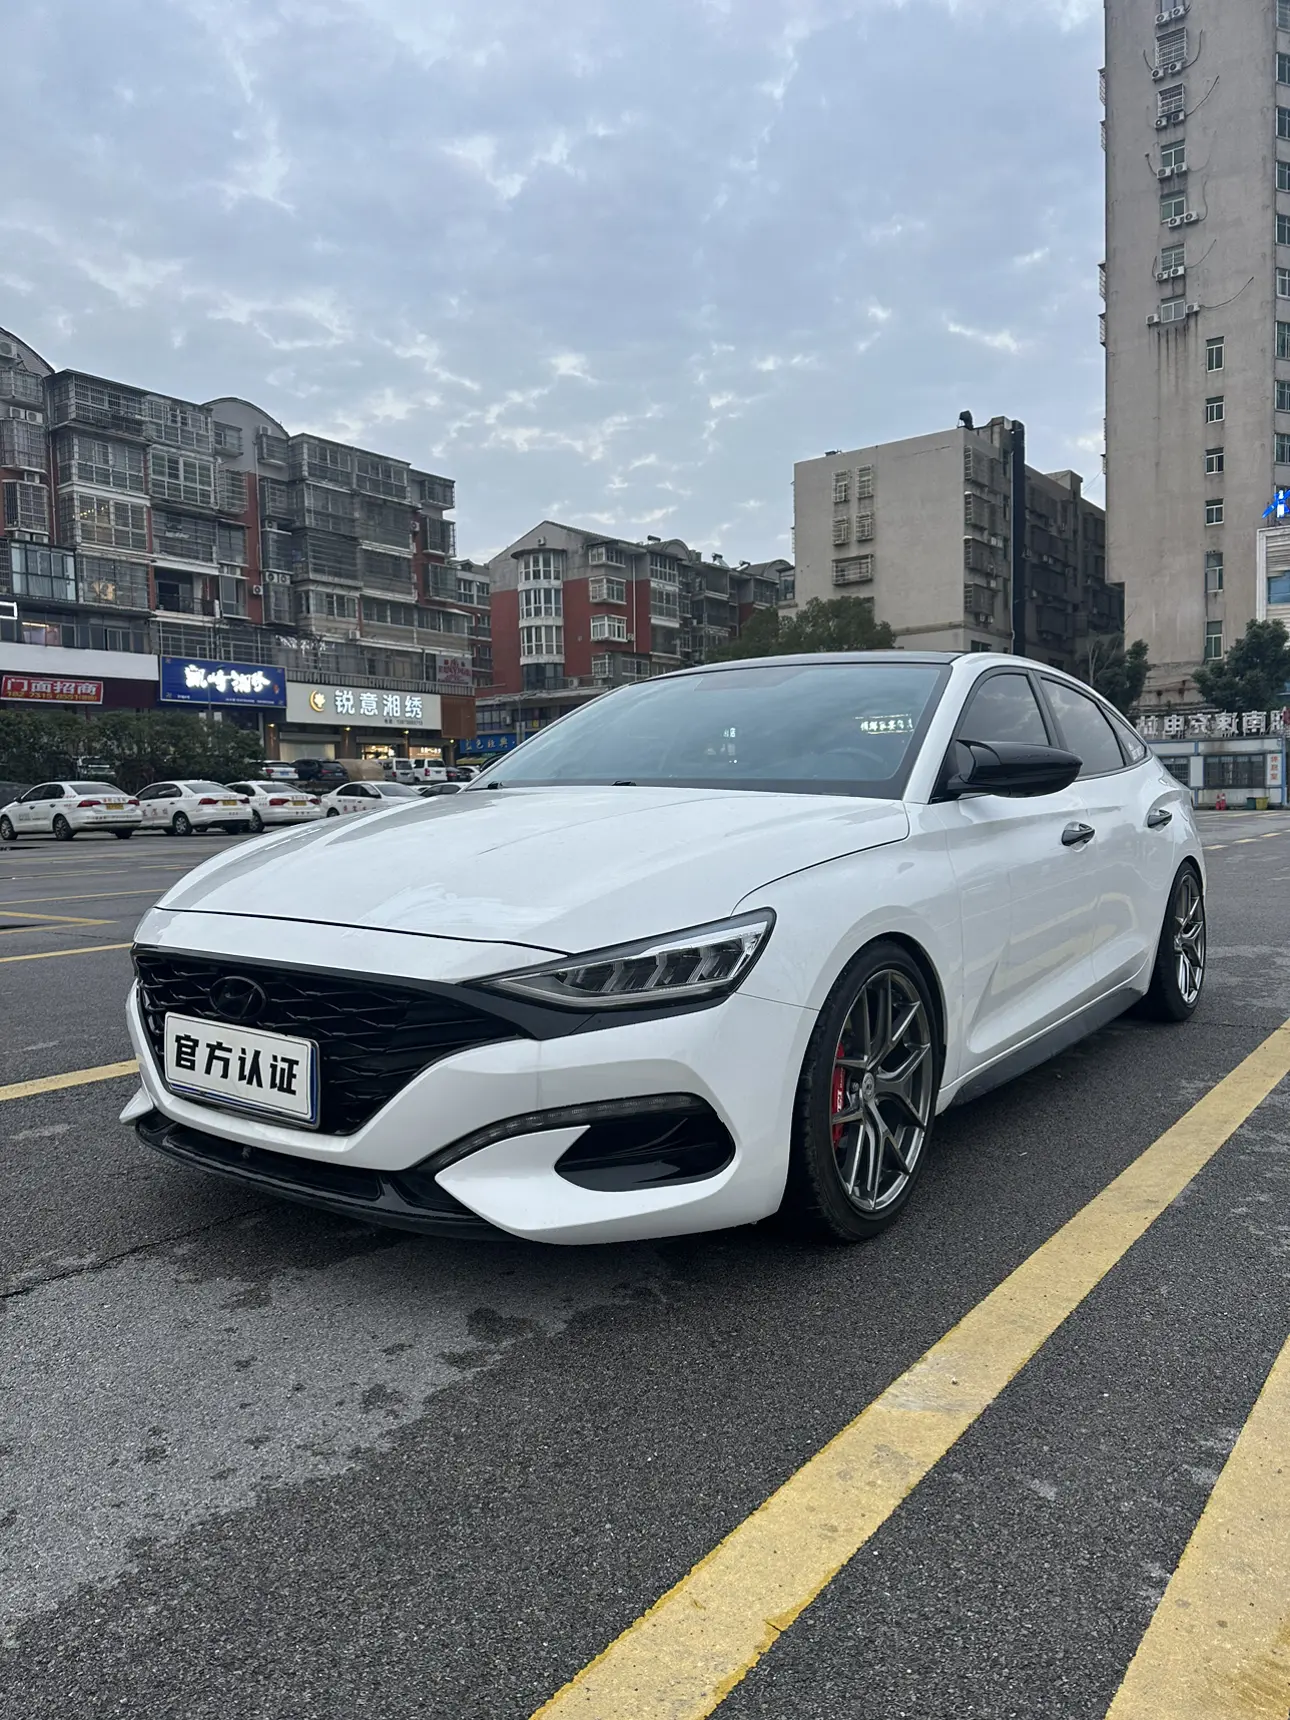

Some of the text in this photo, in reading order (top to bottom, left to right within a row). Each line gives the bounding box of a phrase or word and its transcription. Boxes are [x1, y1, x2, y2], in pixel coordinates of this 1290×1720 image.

[7, 678, 98, 696] 门面招商
[334, 690, 423, 719] 锐意湘绣
[174, 1034, 300, 1096] 官方认证
